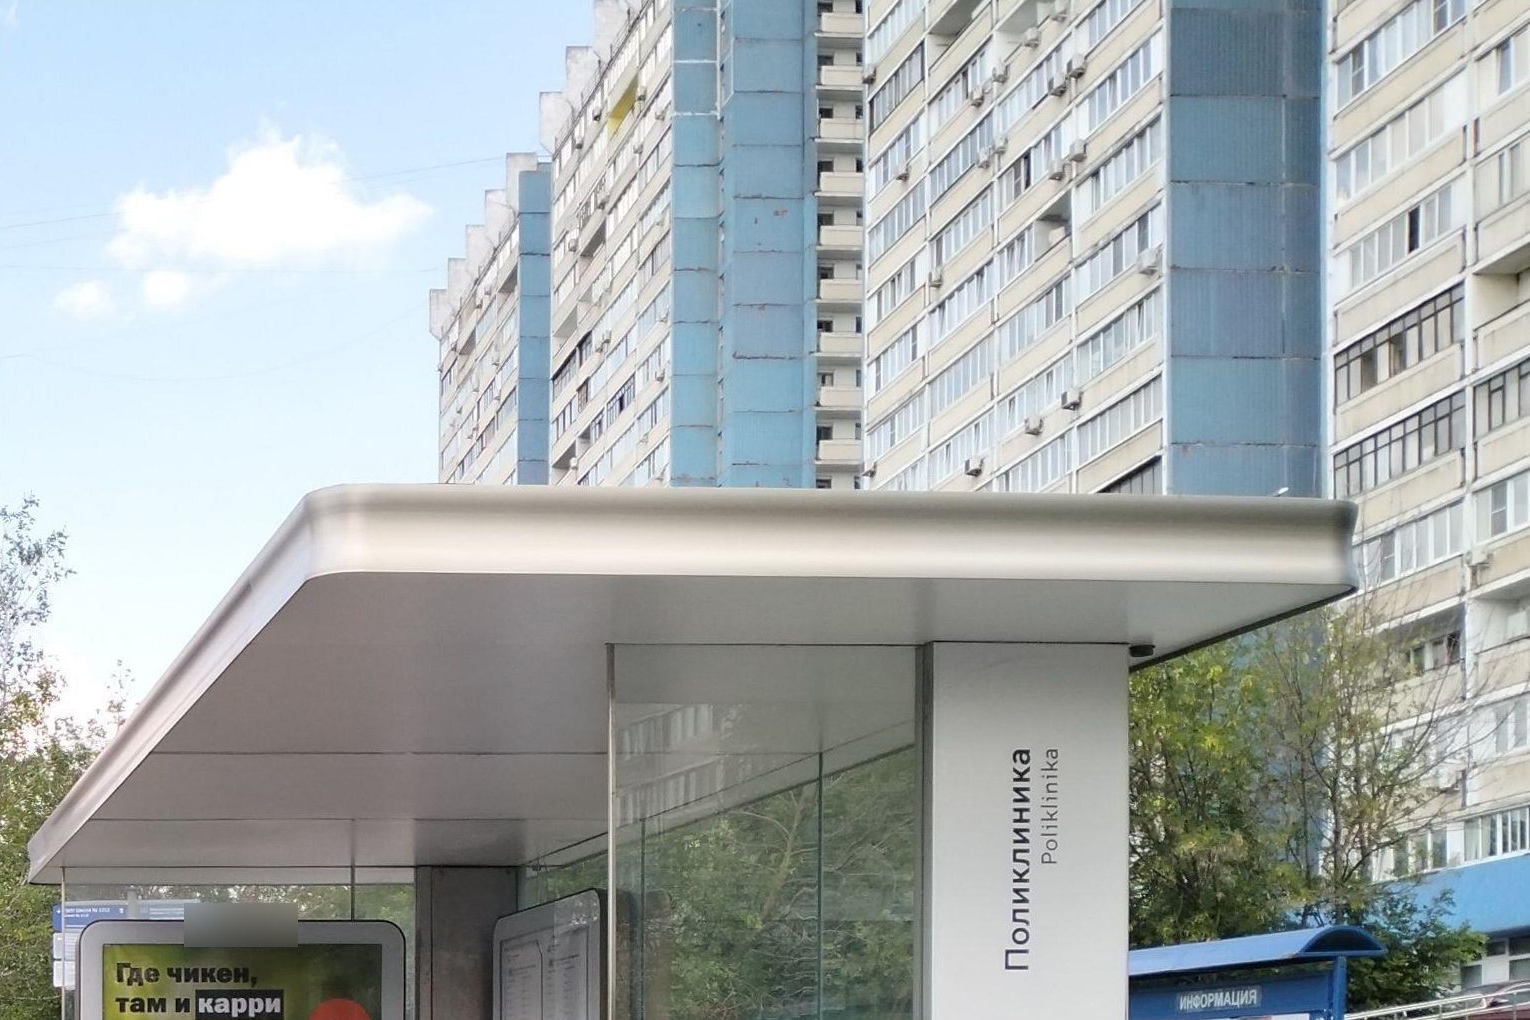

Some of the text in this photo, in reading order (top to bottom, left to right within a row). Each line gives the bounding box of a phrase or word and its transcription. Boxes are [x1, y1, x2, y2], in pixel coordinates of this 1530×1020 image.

[1040, 748, 1058, 864] Poliklinika
[1004, 748, 1031, 970] Поликлиника
[116, 962, 258, 987] Где чикен,
[115, 997, 281, 1018] там и карри
[1179, 989, 1258, 1010] ИНФОРМАЦИЯ
